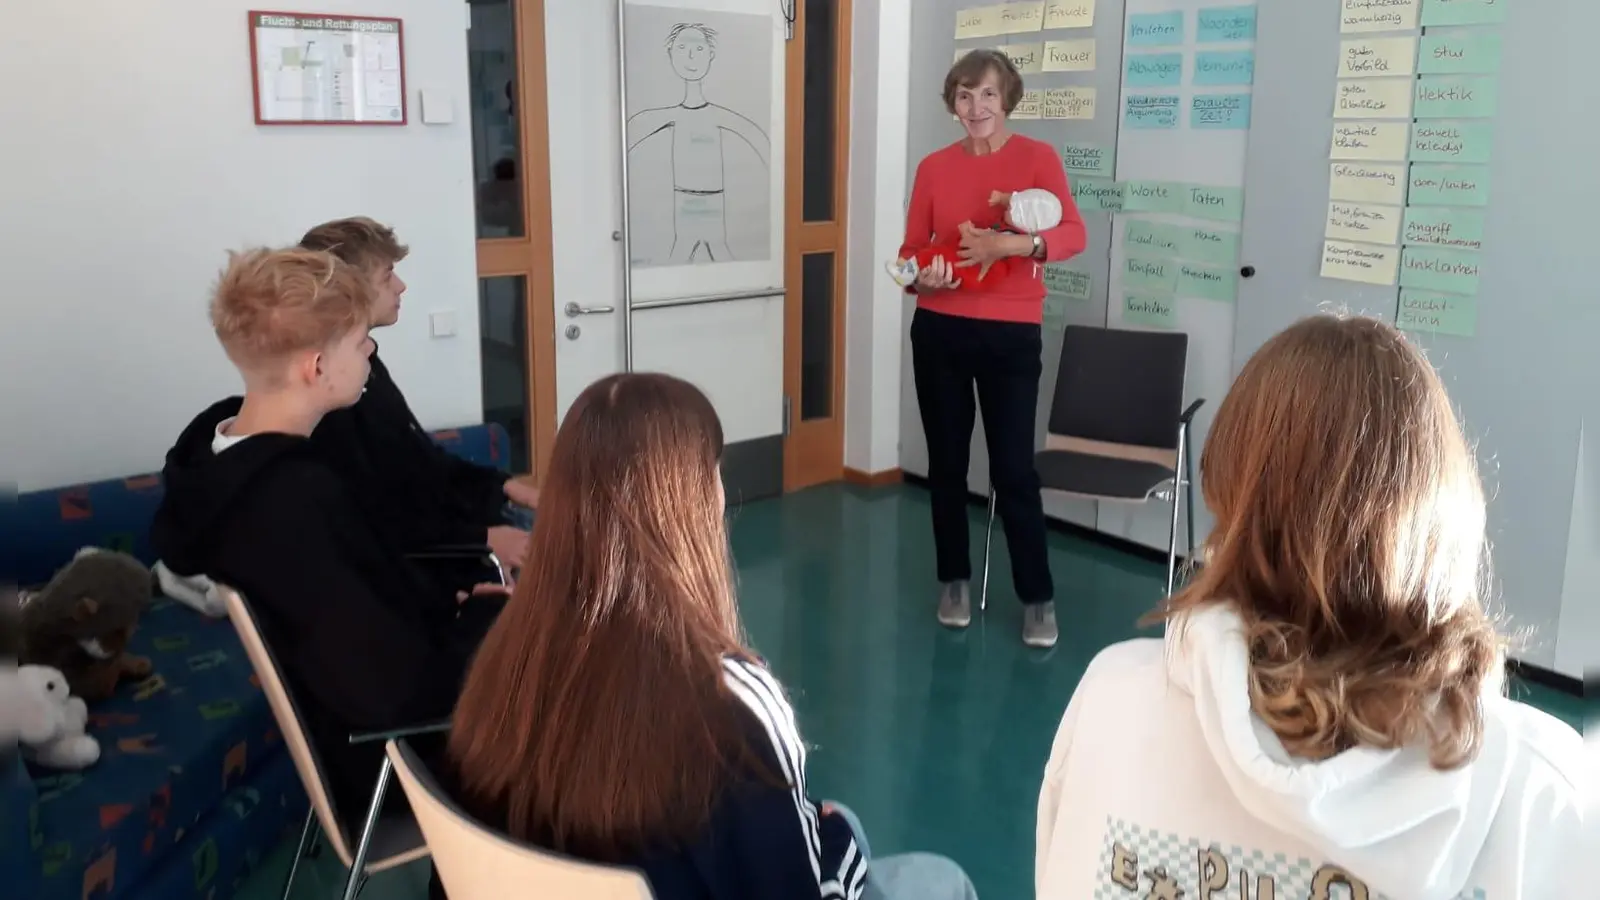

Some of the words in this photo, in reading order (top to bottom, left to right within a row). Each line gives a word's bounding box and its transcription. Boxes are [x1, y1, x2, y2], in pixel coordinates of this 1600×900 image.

[260, 15, 300, 26] Flucht-
[302, 18, 322, 28] und
[325, 19, 393, 32] Rettungsplan
[1009, 51, 1036, 69] ngst
[1047, 47, 1091, 63] Trauer
[1418, 86, 1473, 101] Hektik
[1065, 158, 1101, 168] ebene
[1130, 184, 1169, 198] Worte
[1189, 188, 1224, 205] Taten
[1407, 221, 1452, 236] Angriff
